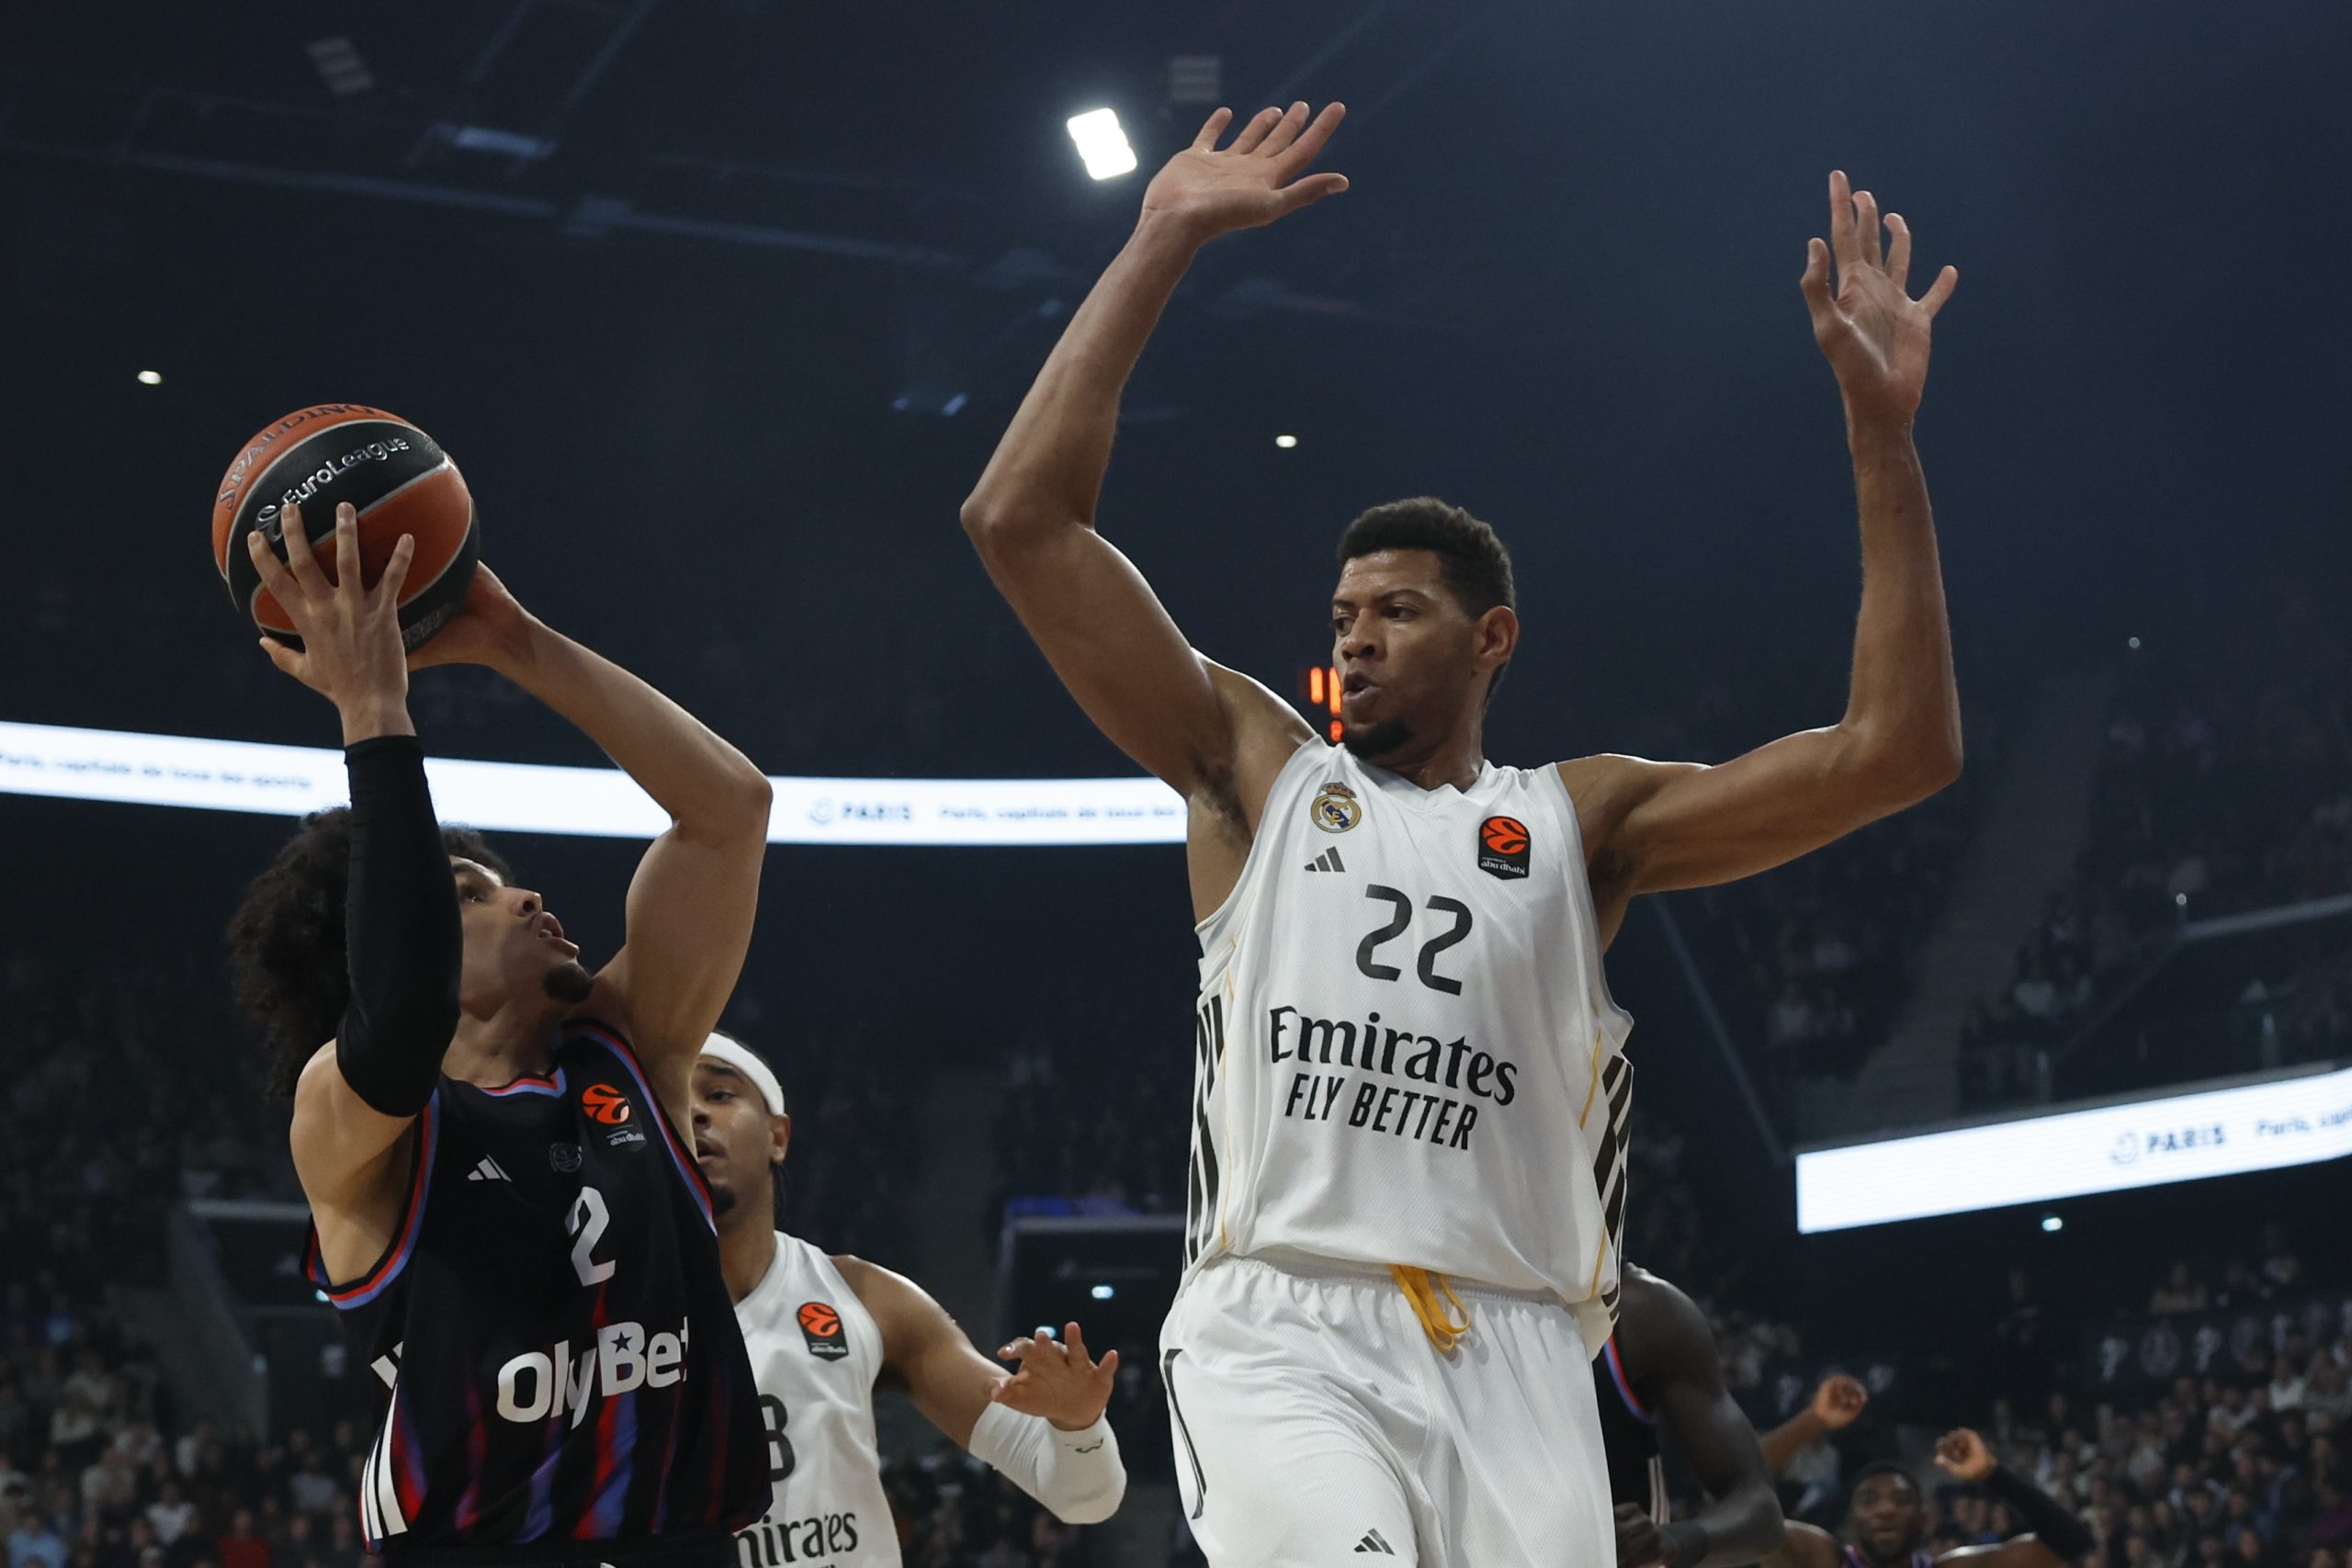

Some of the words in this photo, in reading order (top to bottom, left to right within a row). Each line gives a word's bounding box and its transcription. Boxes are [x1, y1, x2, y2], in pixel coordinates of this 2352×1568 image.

[281, 436, 410, 506] EuroLeague
[842, 802, 912, 821] PARIS
[1356, 883, 1473, 996] 22
[1270, 1006, 1517, 1106] Emirates
[1285, 1073, 1345, 1121] FLY
[1349, 1082, 1478, 1150] BETTER
[2147, 1124, 2226, 1155] PARIS
[564, 1186, 616, 1287] 2
